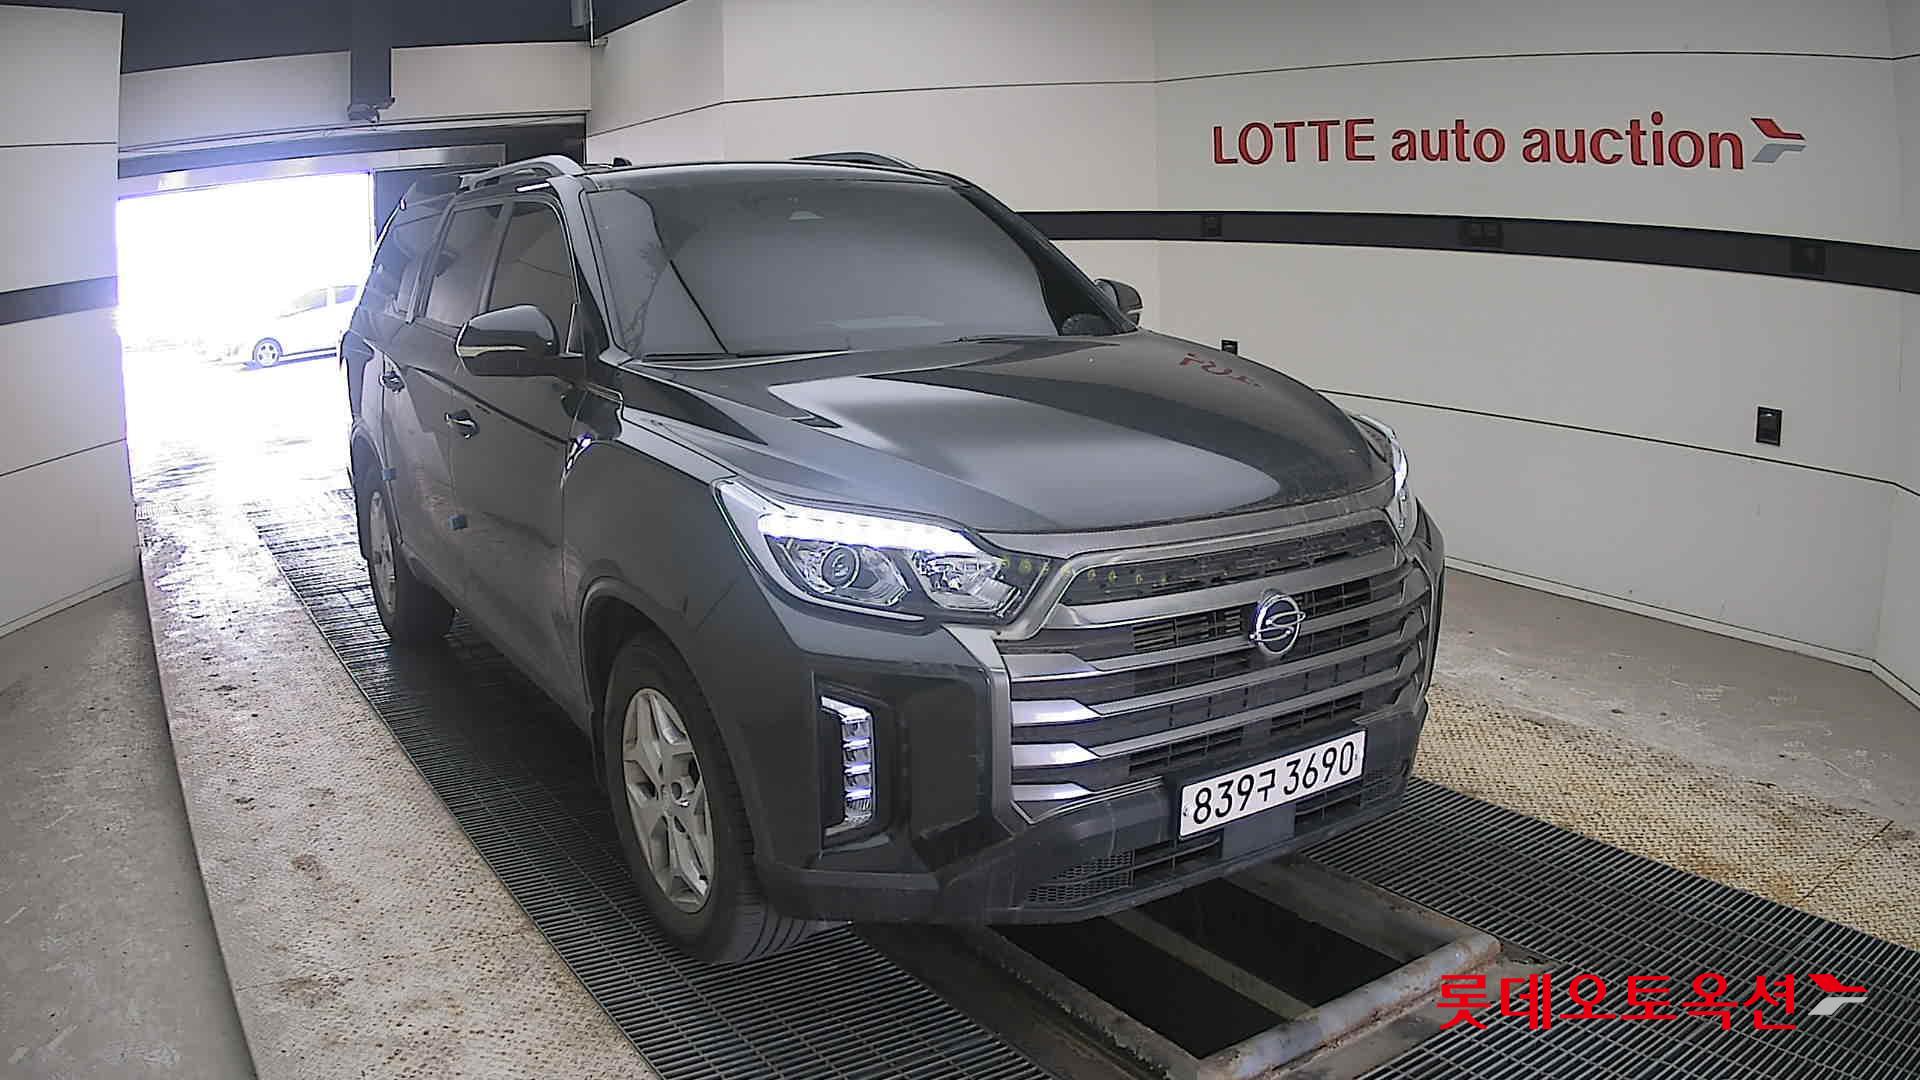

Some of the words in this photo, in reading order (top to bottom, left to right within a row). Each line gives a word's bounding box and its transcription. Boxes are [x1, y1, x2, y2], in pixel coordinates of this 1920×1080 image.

[1212, 118, 1375, 165] LOTTE
[1391, 118, 1506, 163] auto
[1521, 111, 1744, 169] auction
[1283, 741, 1355, 795] 3690
